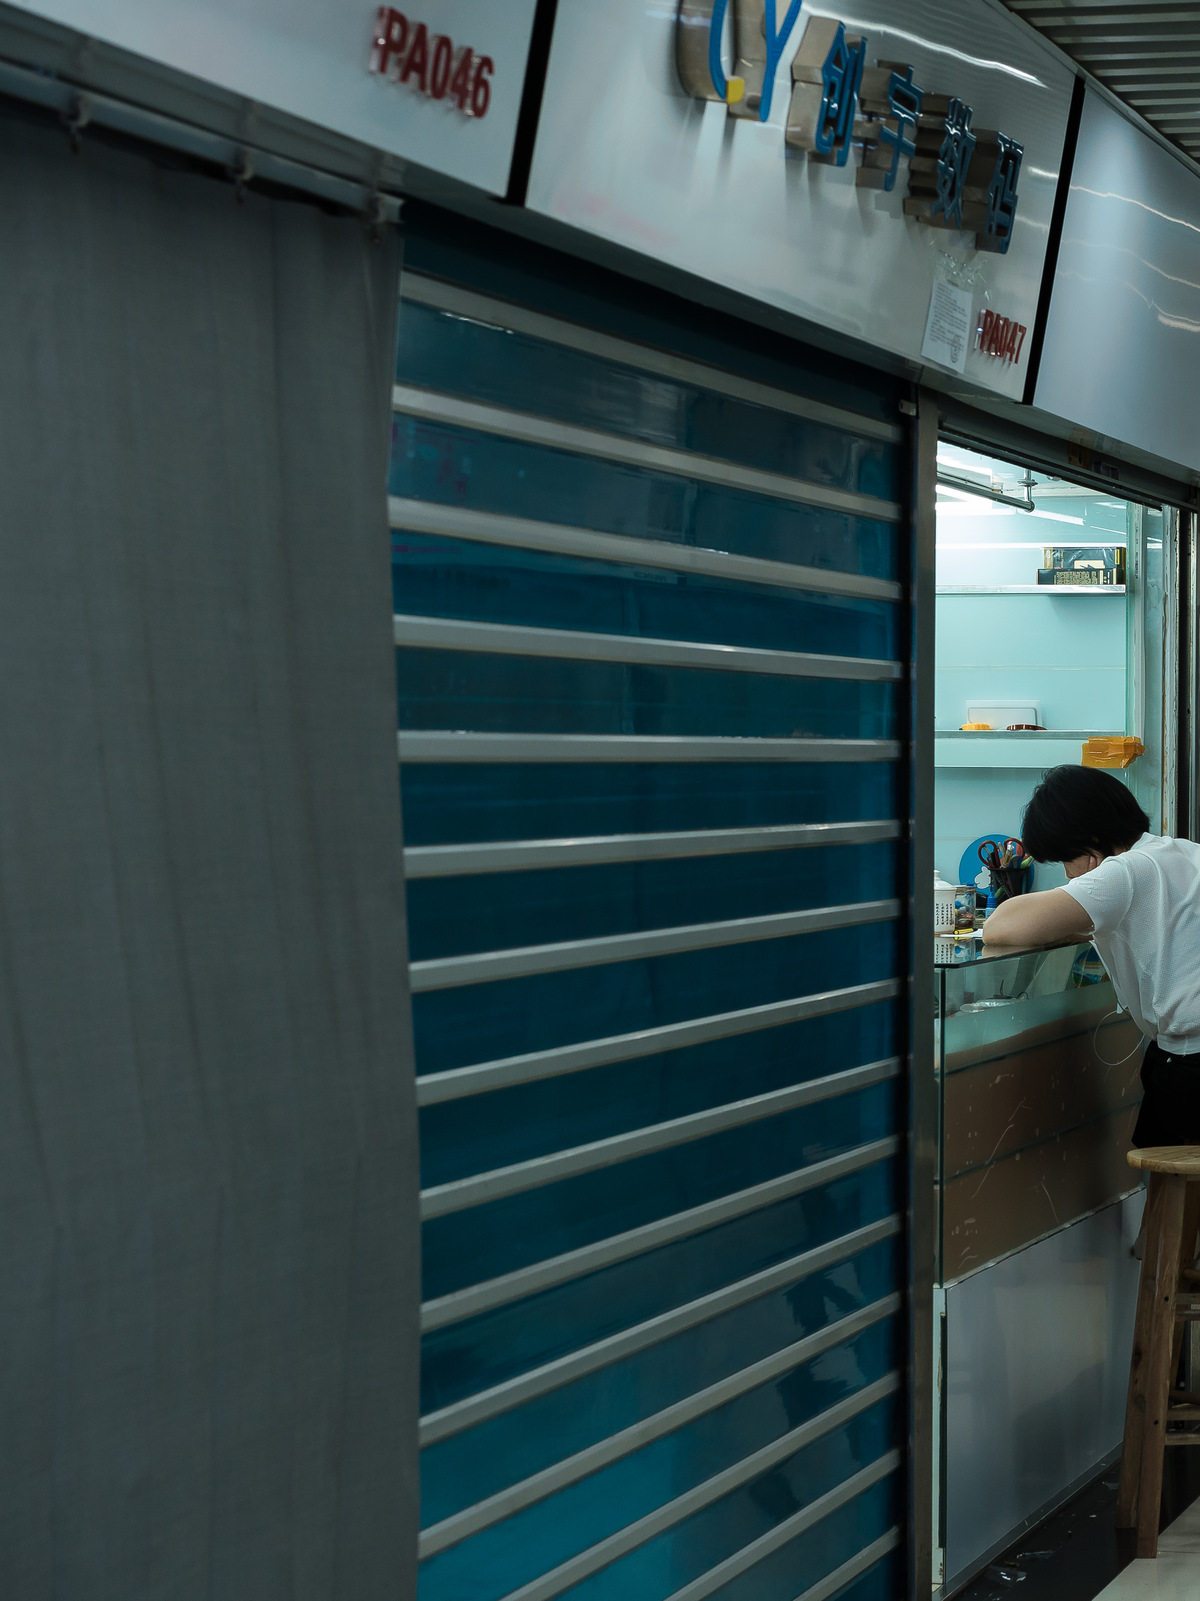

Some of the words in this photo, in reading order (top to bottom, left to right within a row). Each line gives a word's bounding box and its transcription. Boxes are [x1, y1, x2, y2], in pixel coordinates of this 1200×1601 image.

[377, 6, 494, 118] PA046
[815, 21, 1025, 254] 创宇数码
[979, 309, 1027, 364] PA047
